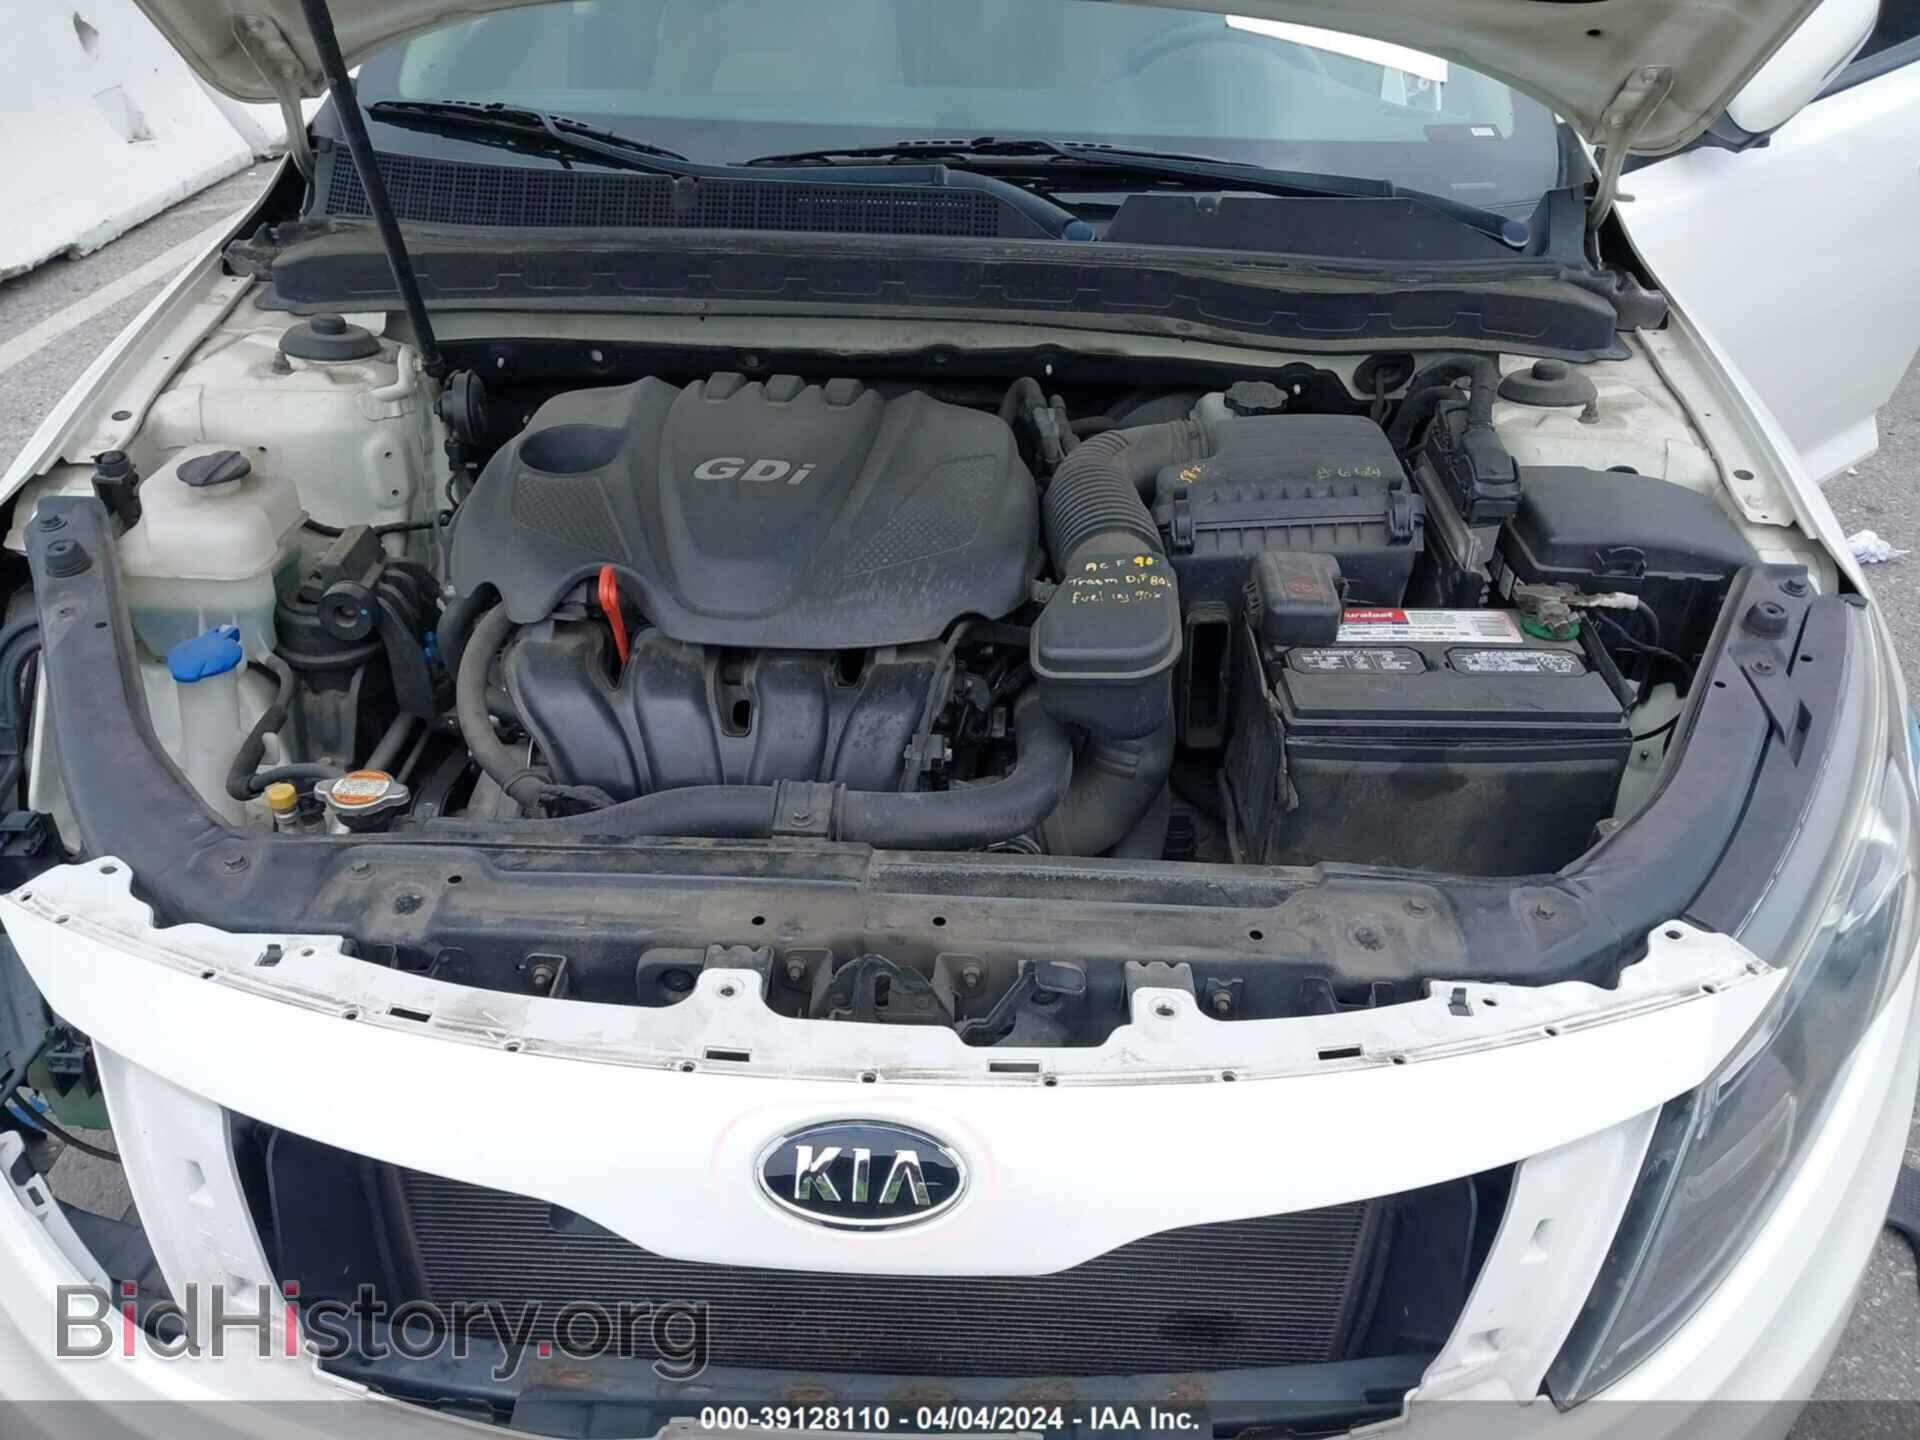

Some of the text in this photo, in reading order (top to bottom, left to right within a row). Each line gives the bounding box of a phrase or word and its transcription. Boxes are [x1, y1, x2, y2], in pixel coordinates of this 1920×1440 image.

[693, 456, 816, 485] GDi
[1343, 611, 1394, 619] uralast
[794, 1145, 931, 1205] KIA
